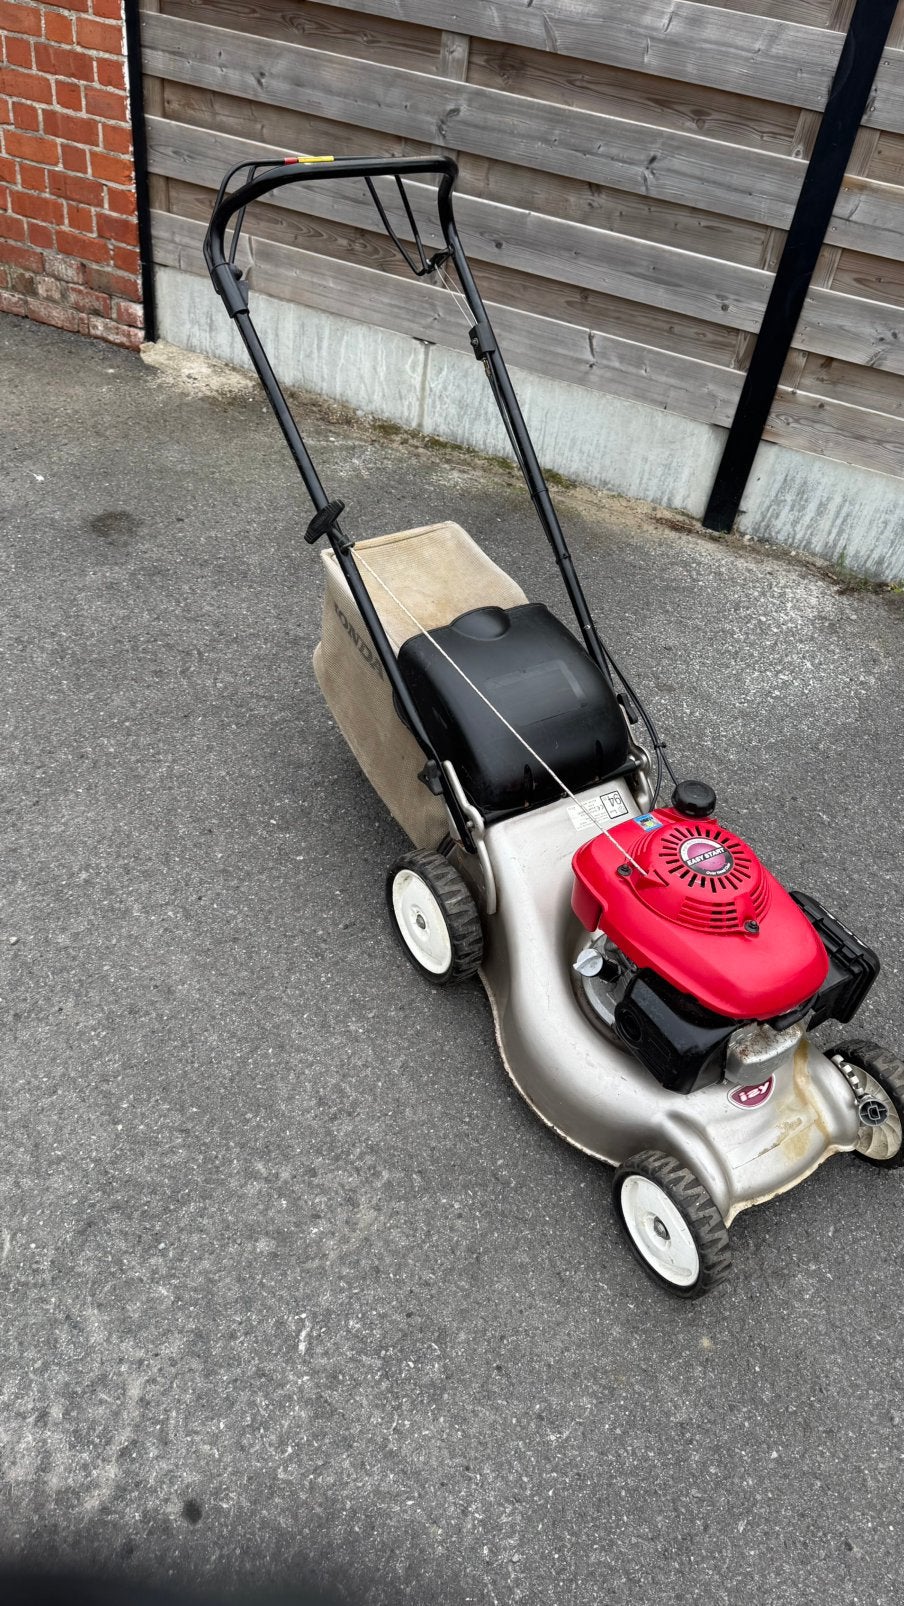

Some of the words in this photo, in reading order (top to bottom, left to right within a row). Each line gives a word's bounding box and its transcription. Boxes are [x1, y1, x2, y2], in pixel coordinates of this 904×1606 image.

[607, 793, 622, 807] 94
[686, 854, 704, 866] EASY
[703, 847, 725, 859] START
[738, 1081, 770, 1102] izy
